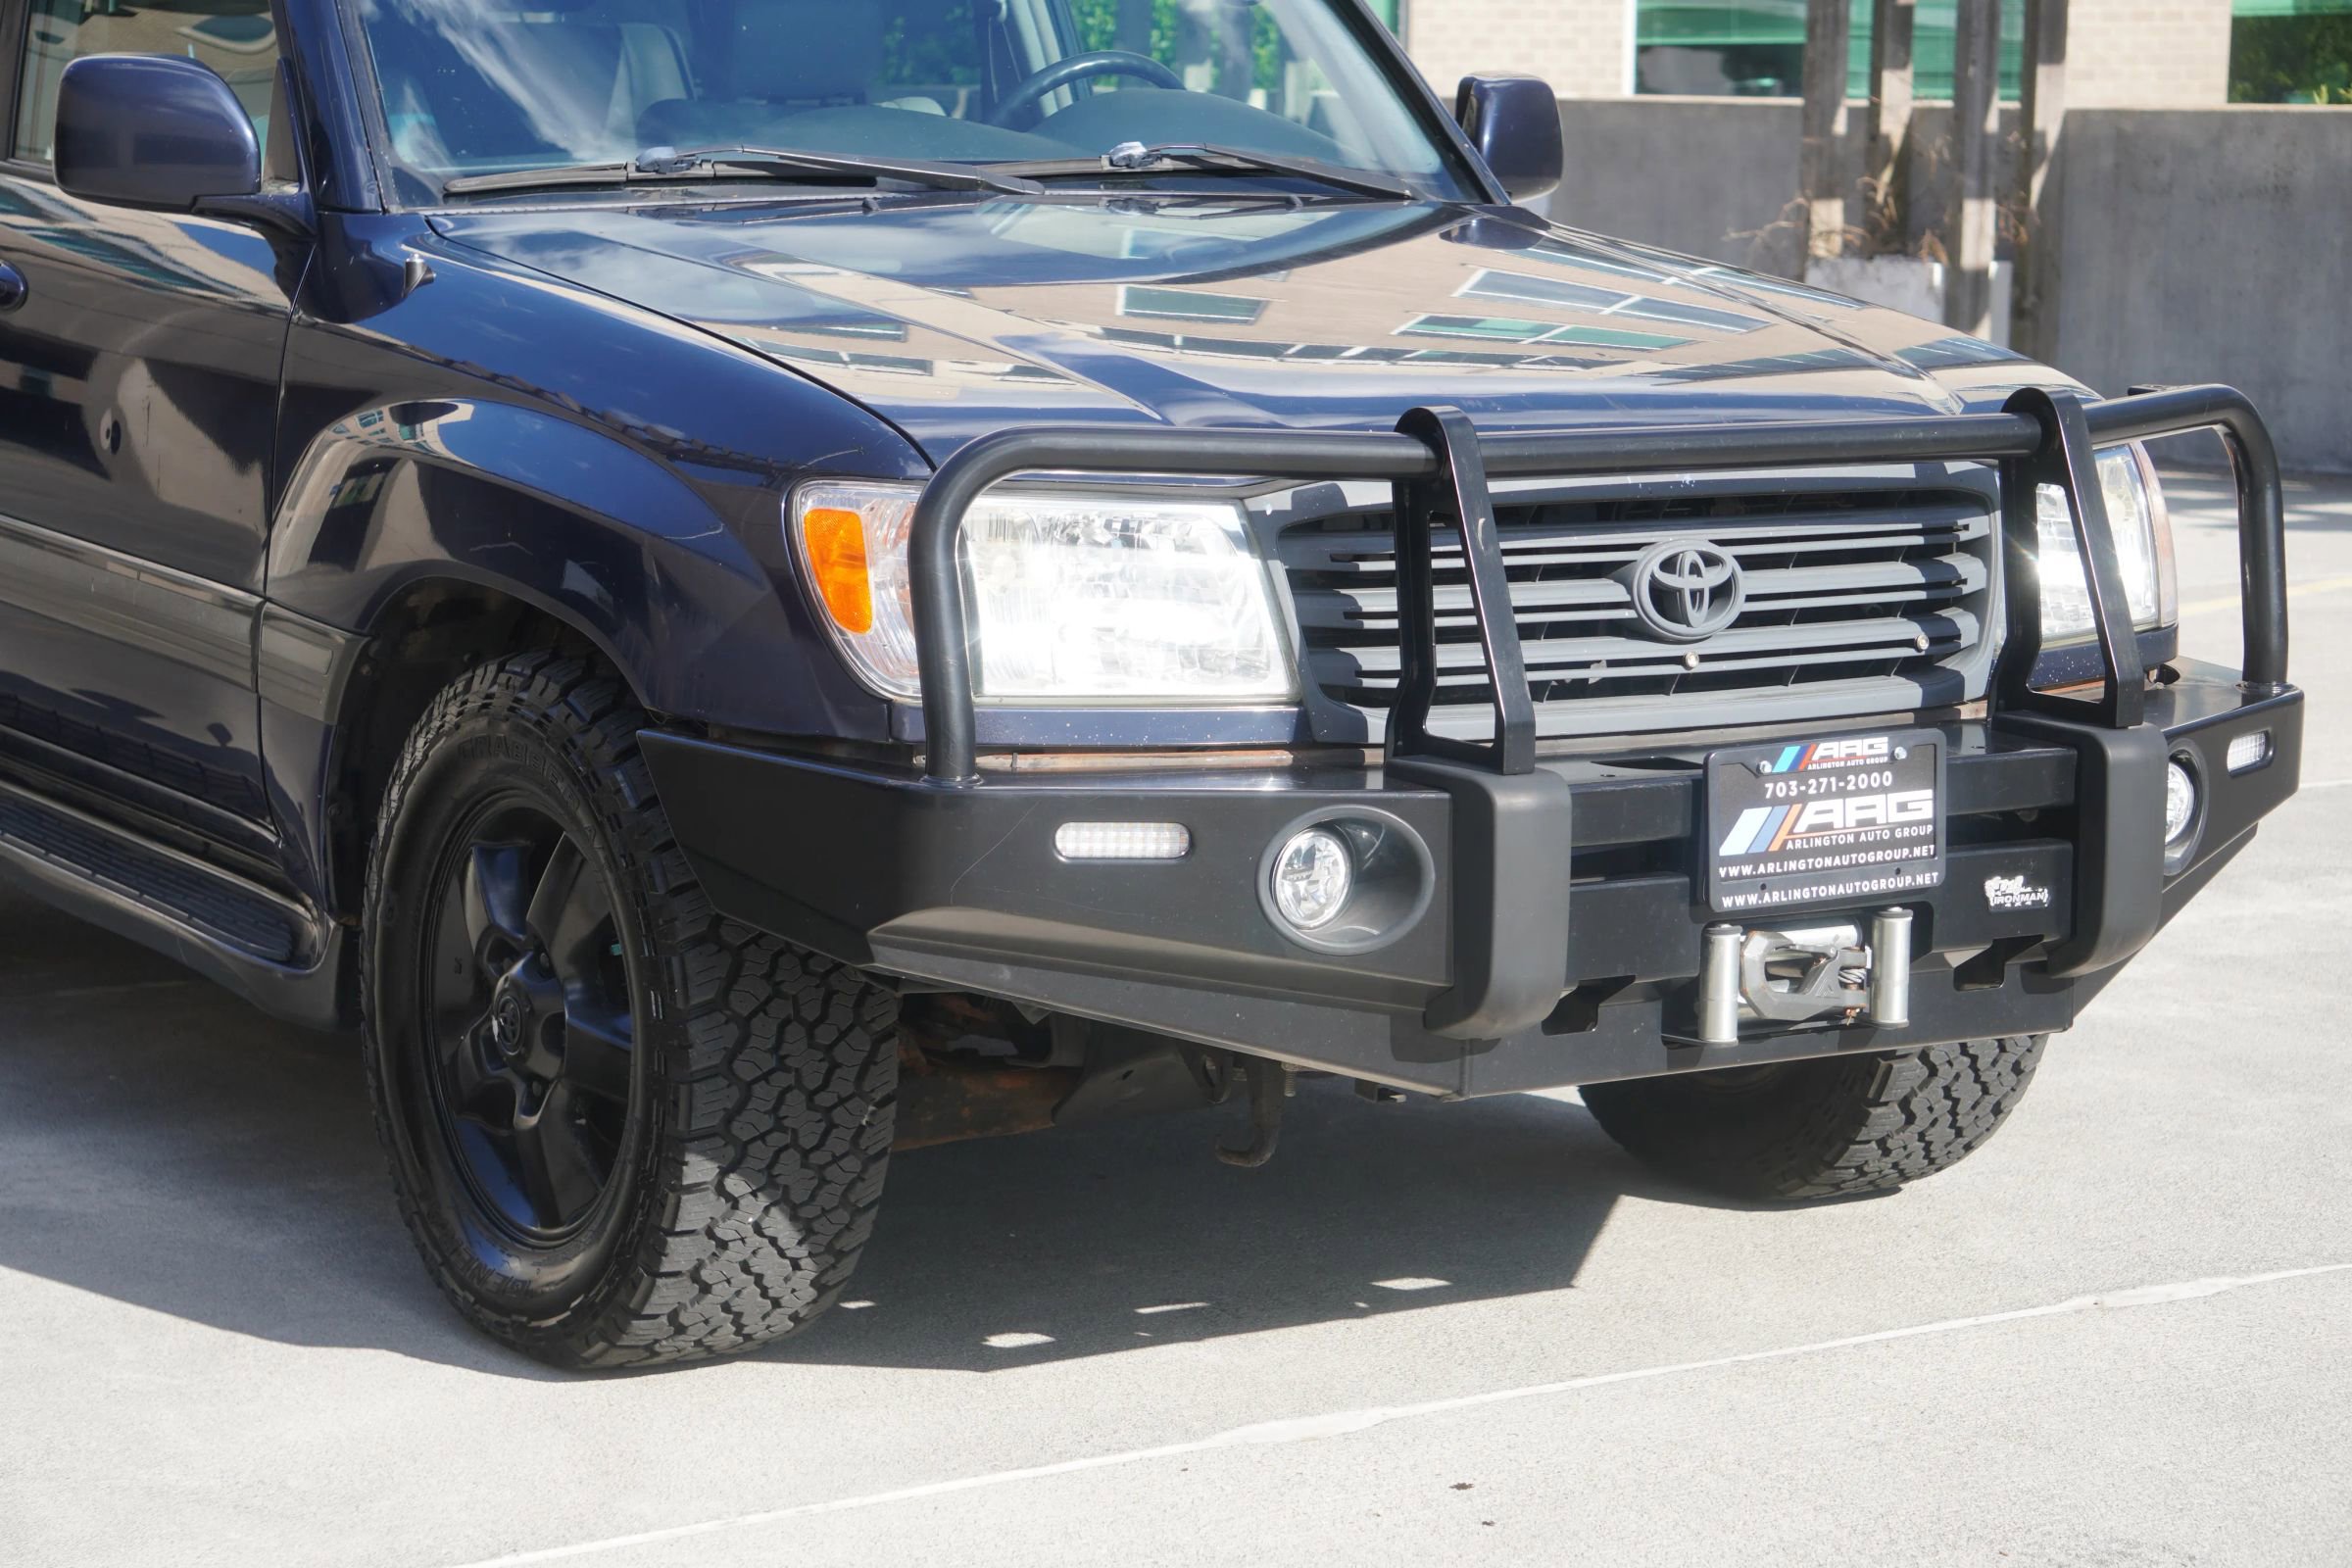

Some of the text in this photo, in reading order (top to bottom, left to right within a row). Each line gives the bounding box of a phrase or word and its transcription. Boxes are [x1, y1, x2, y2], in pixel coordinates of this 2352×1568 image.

[1811, 737, 1888, 761] AAG
[1807, 756, 1888, 771] ARLINGTON AUTO GROUP
[1764, 770, 1893, 800] 703-271-2000
[1792, 789, 1934, 834] AAG
[1786, 824, 1934, 851] ARLINGTON AUTO GROUP
[1722, 871, 1939, 908] WWW.ARLINGTONAUTOGROUP.NET
[1993, 892, 2045, 905] IRONMAN
